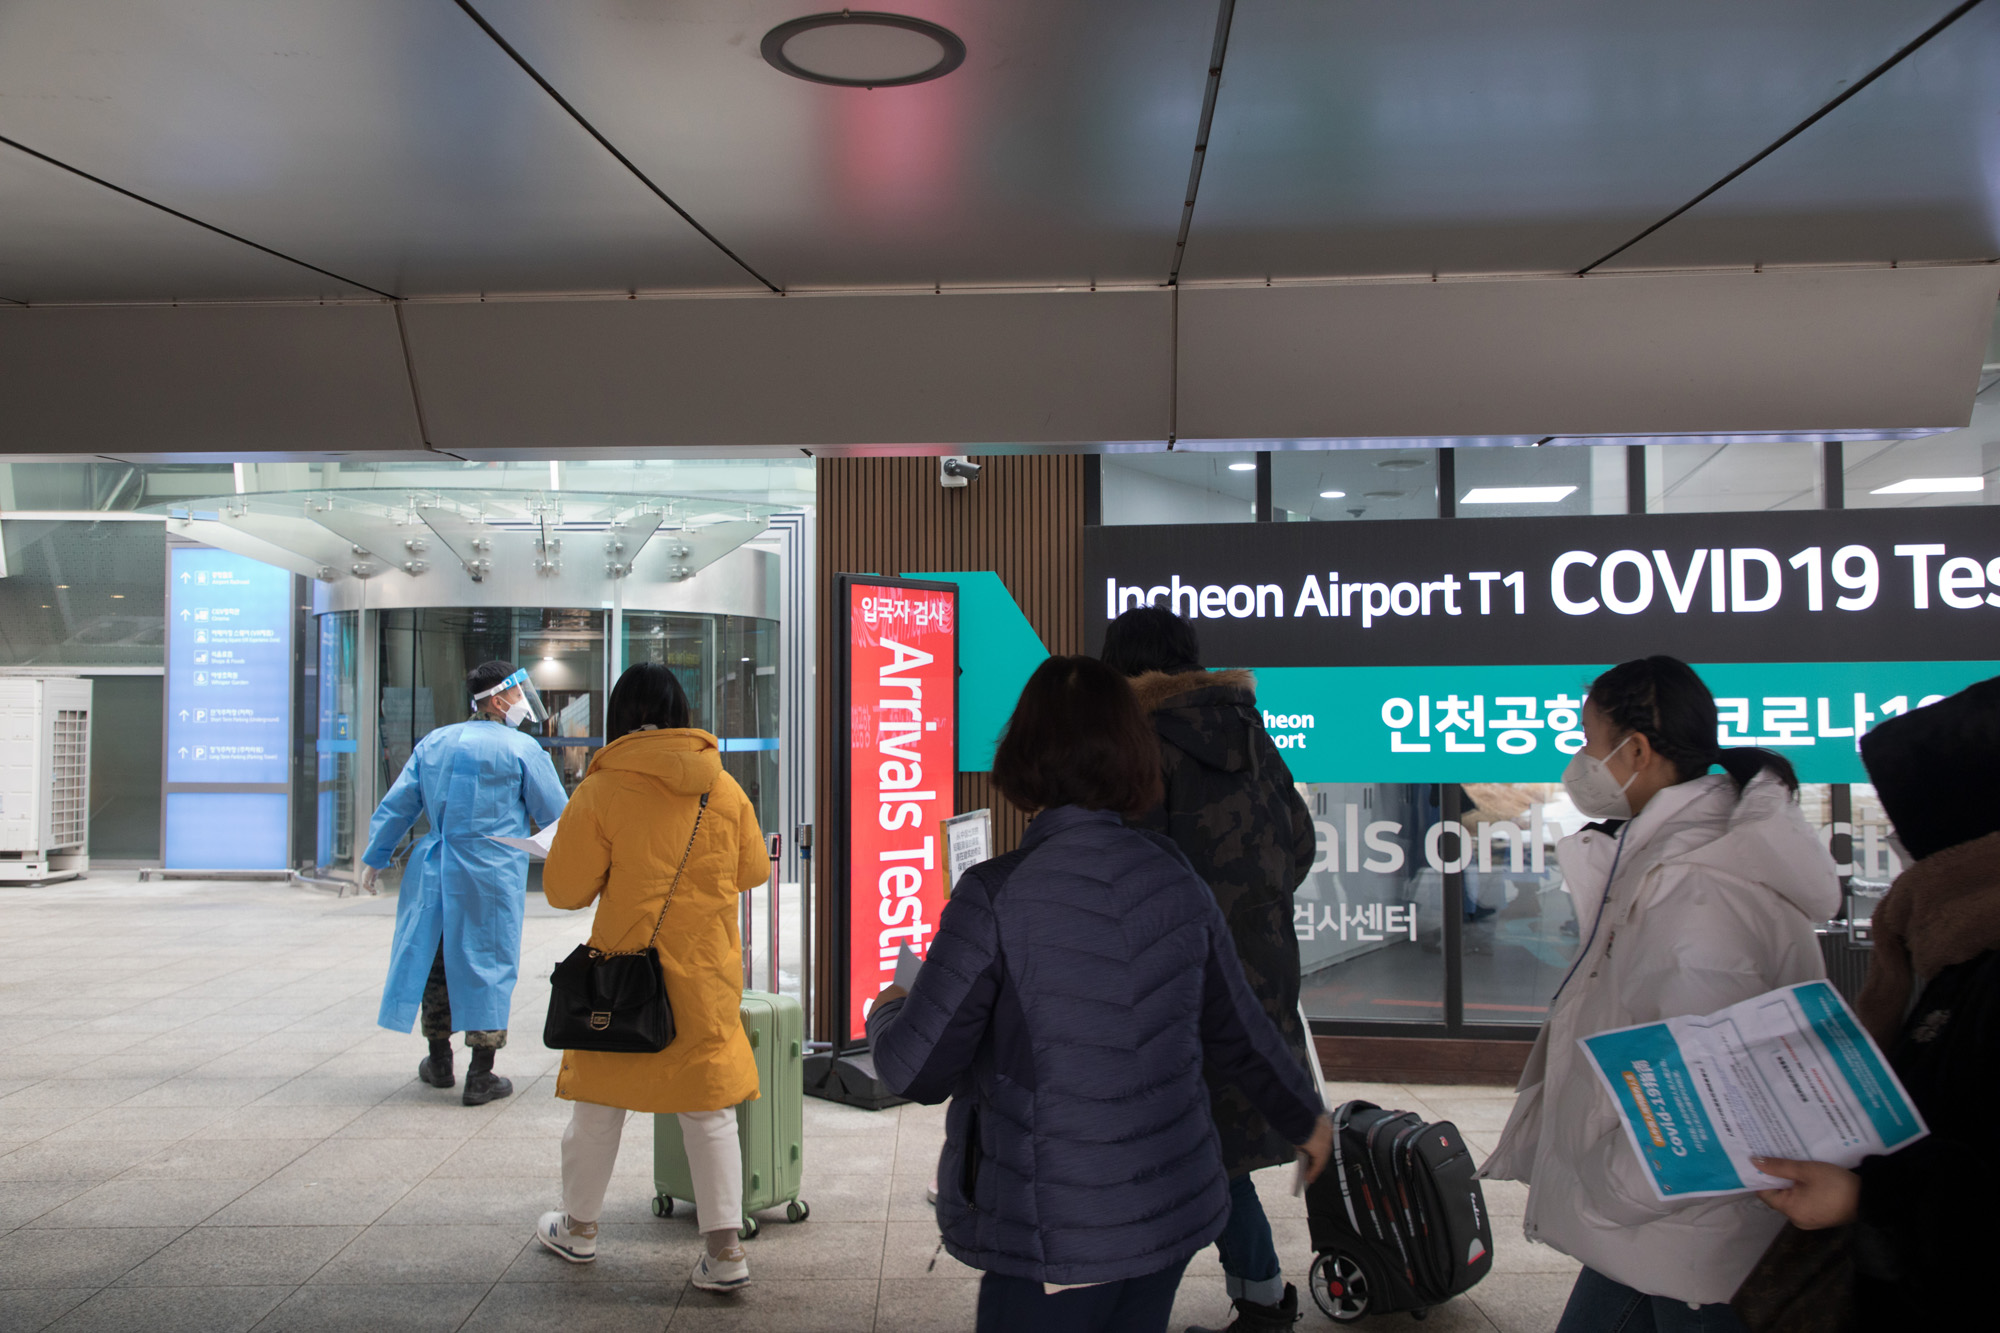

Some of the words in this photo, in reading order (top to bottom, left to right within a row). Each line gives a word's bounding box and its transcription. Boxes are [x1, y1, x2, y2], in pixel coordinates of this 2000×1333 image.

[861, 597, 910, 625] 입국자
[913, 601, 944, 627] 검사
[1106, 574, 1284, 620] Incheon
[1294, 571, 1462, 628] Airport
[1468, 571, 1525, 615] T1
[878, 637, 937, 830] Arrivals
[1263, 709, 1315, 729] heon
[1269, 732, 1307, 749] ort
[1381, 694, 1588, 756] 인천공항
[1309, 803, 1405, 874] als
[1293, 902, 1418, 942] 검사센터
